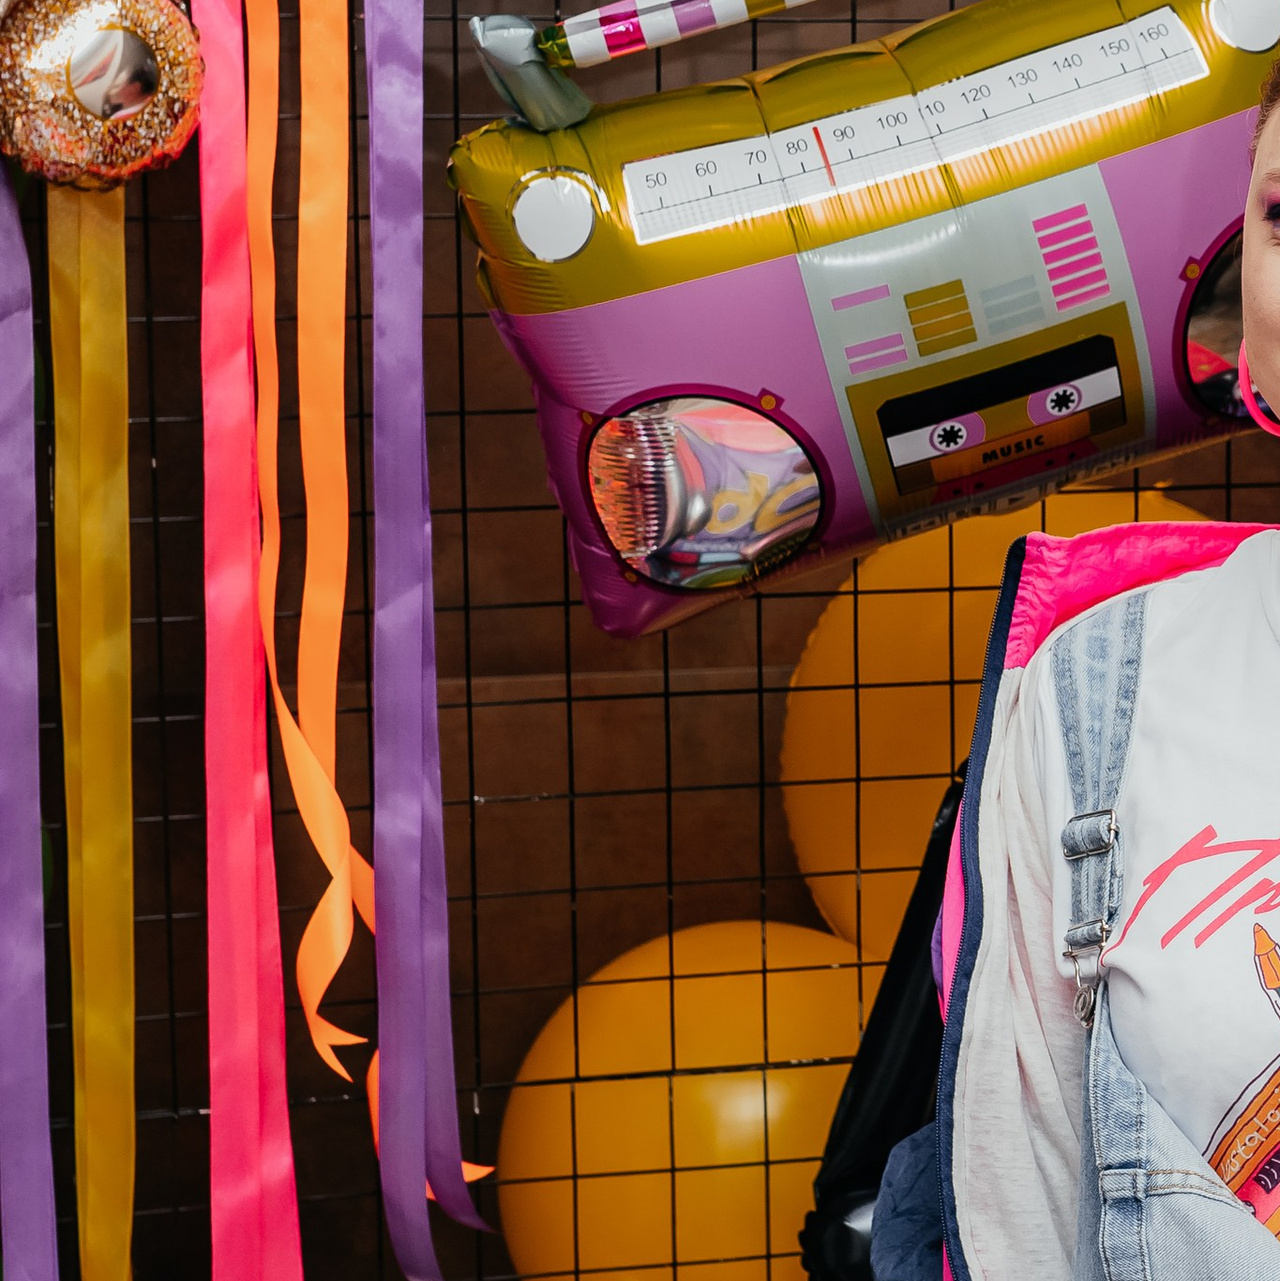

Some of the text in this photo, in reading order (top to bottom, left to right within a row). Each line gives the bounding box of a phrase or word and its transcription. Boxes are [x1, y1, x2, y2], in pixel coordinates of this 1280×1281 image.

[645, 171, 667, 189] 50
[695, 160, 717, 178] 60
[744, 149, 767, 166] 70
[786, 138, 808, 156] 80
[832, 125, 855, 142] 90
[877, 111, 908, 130] 100
[960, 84, 991, 105] 120
[1007, 68, 1038, 89] 130
[1052, 53, 1083, 73] 140
[1099, 38, 1130, 59] 150
[1139, 23, 1169, 44] 160
[982, 434, 1044, 464] MUSIC
